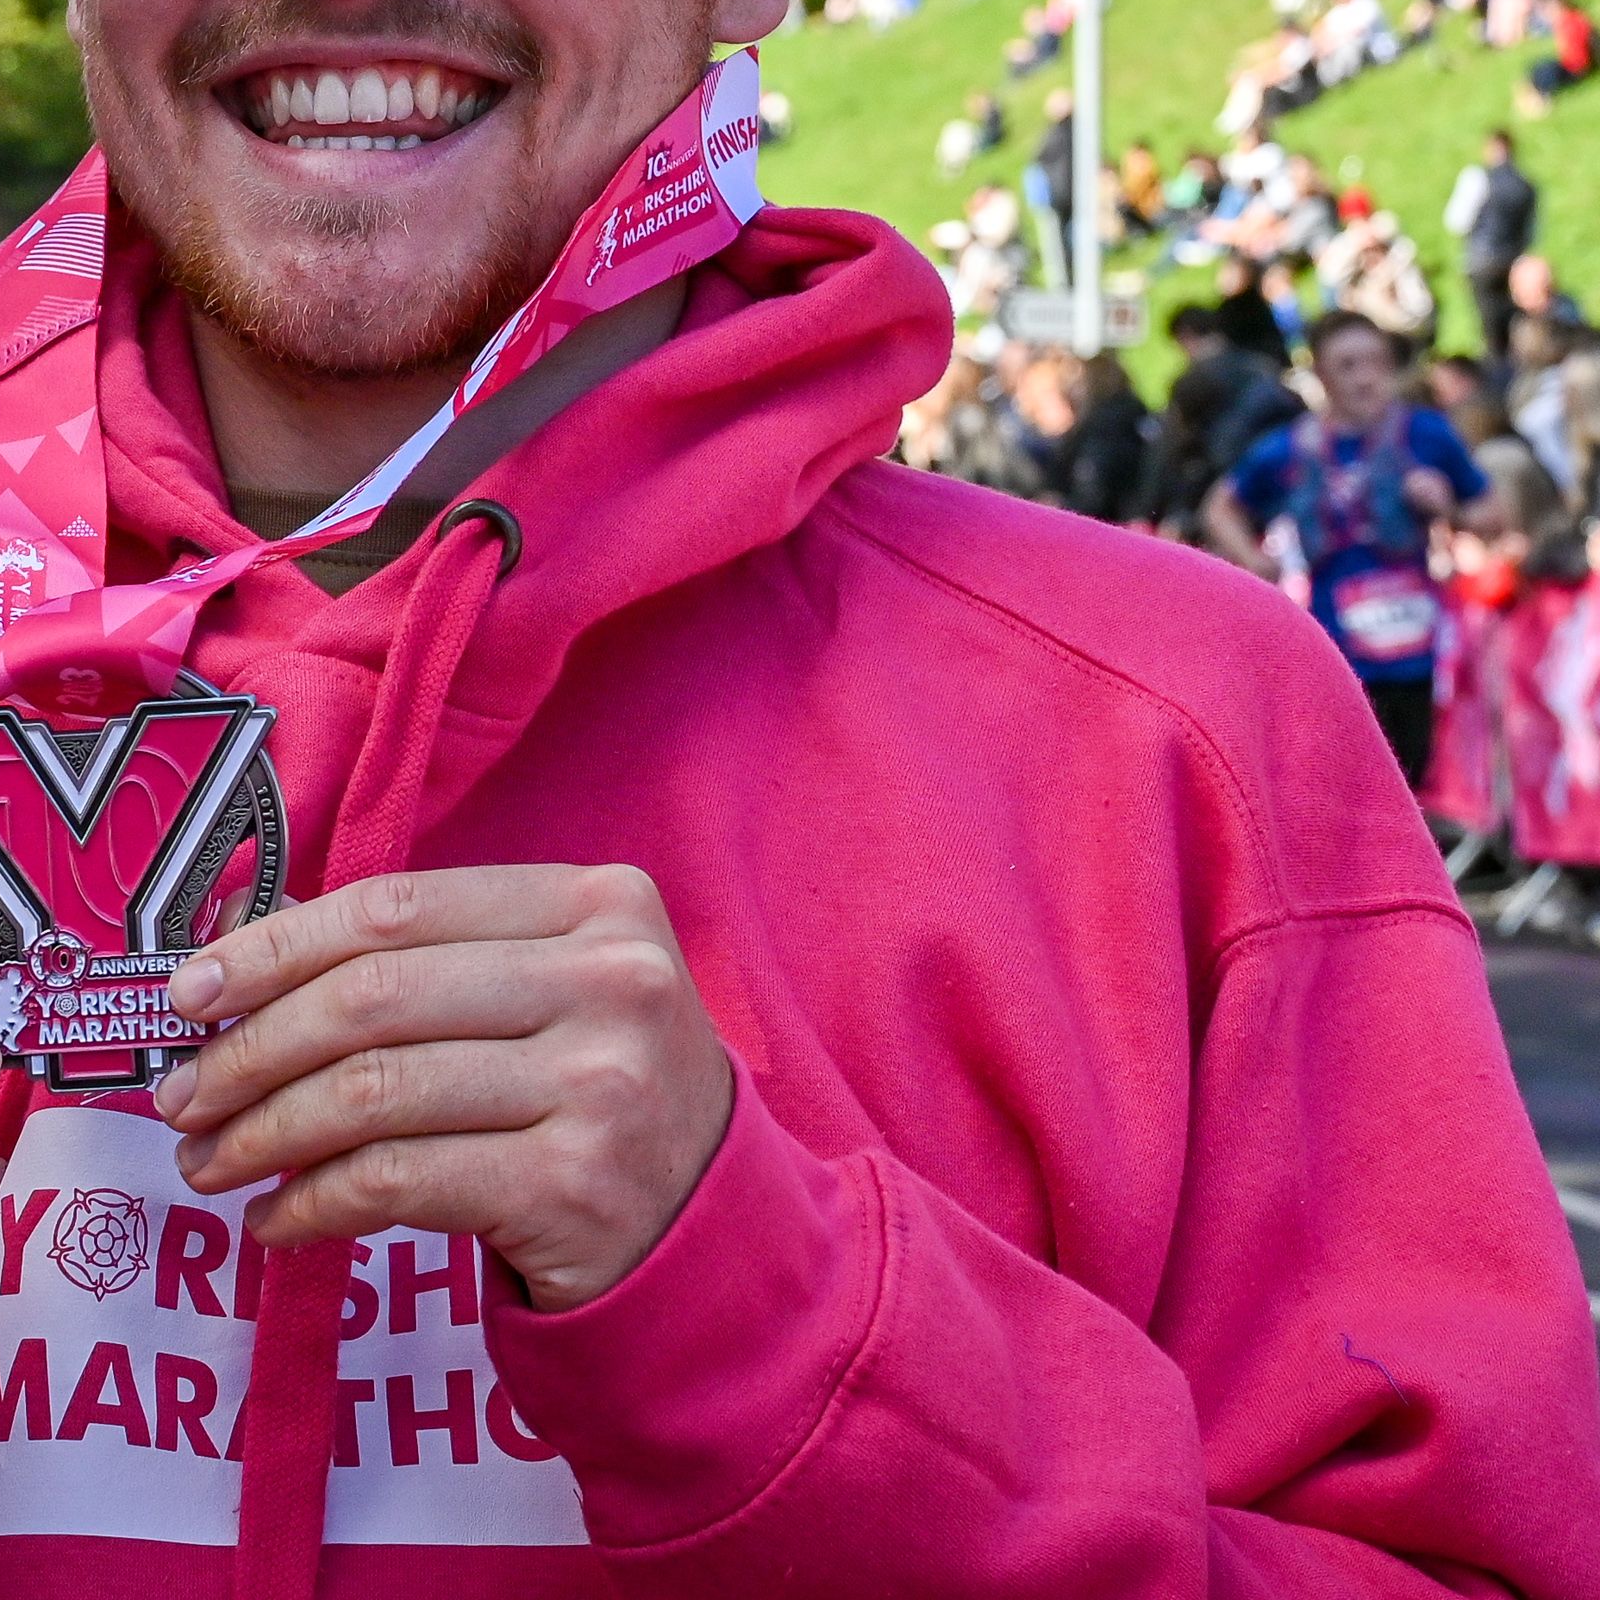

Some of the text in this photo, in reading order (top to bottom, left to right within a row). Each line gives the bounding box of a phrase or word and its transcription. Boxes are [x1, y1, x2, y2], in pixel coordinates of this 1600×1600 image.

[707, 115, 758, 169] FINISH
[622, 187, 712, 248] MARATHON
[257, 786, 277, 833] 10TH
[38, 1014, 206, 1045] MARATHON
